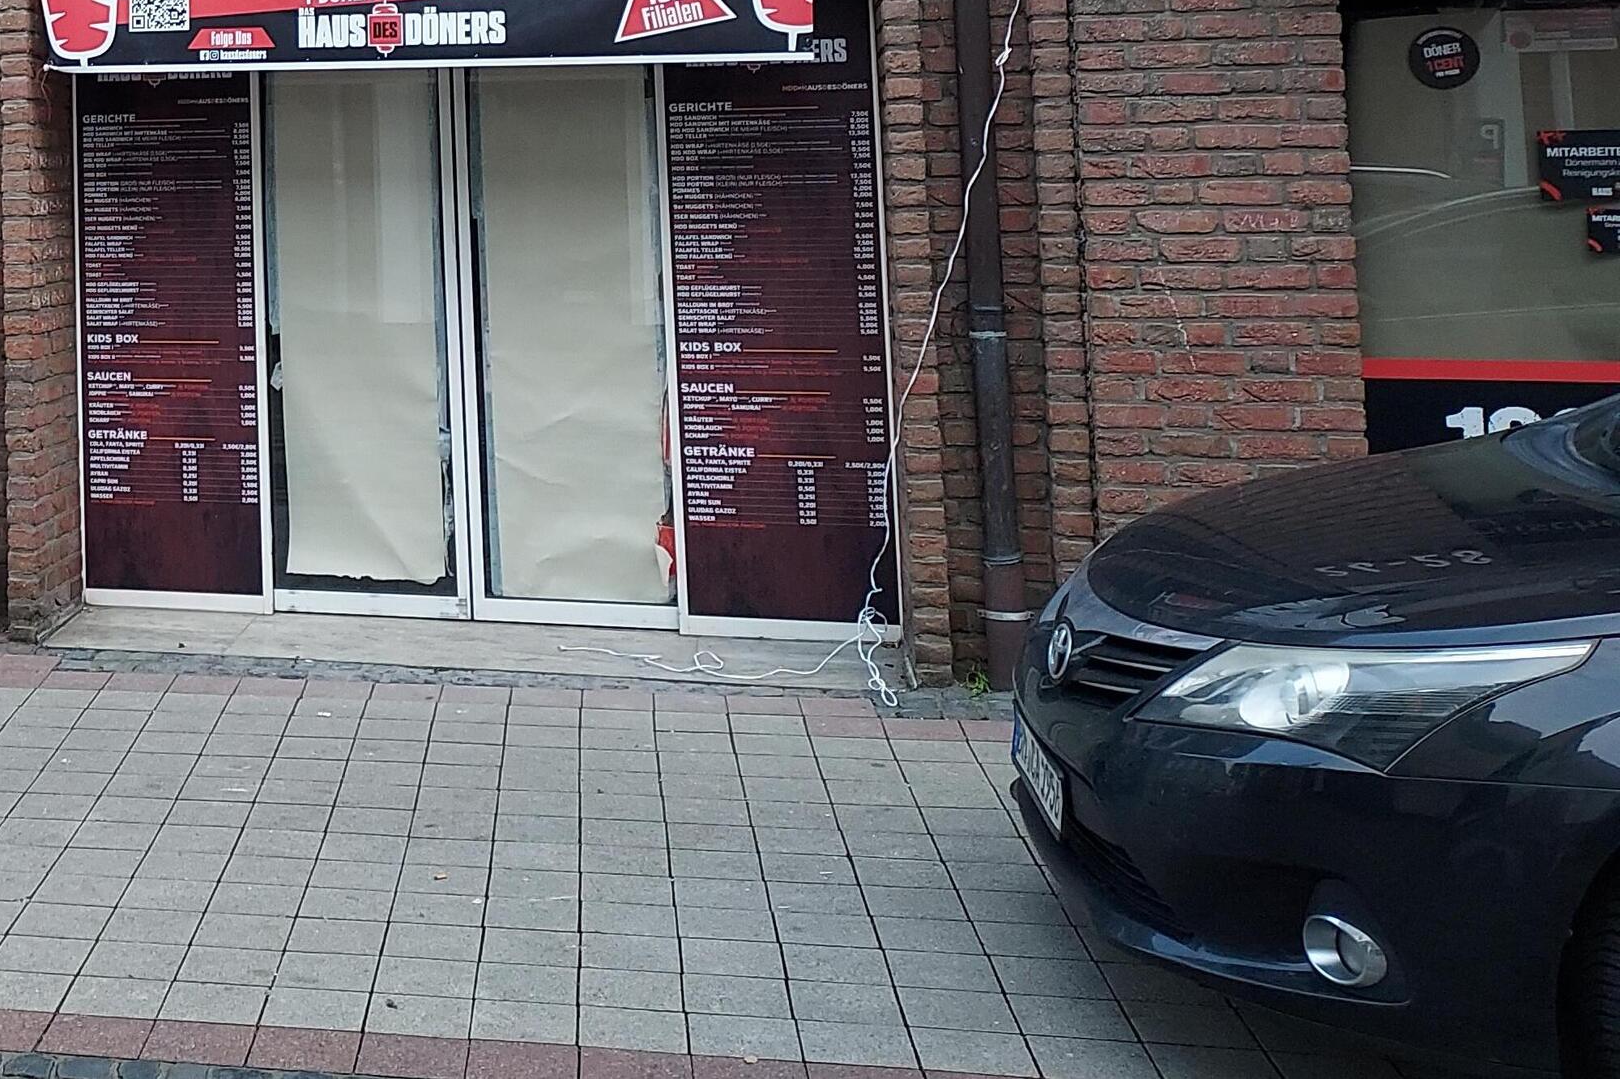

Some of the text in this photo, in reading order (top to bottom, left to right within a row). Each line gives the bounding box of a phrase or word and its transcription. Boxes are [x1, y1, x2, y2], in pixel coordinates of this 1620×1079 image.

[641, 1, 704, 30] Filialen
[298, 7, 507, 49] HAUS DES DÖNERS
[211, 31, 233, 47] Folge
[669, 102, 733, 112] GERICHTE
[82, 114, 136, 124] GERICHTE
[87, 334, 139, 344] KIDS BOX
[680, 342, 742, 352] KIDS BOX
[87, 372, 132, 382] SAUCEN
[680, 383, 734, 393] SAUCEN
[88, 428, 148, 440] GETRÄNKE
[684, 444, 755, 457] GETRÄNKE
